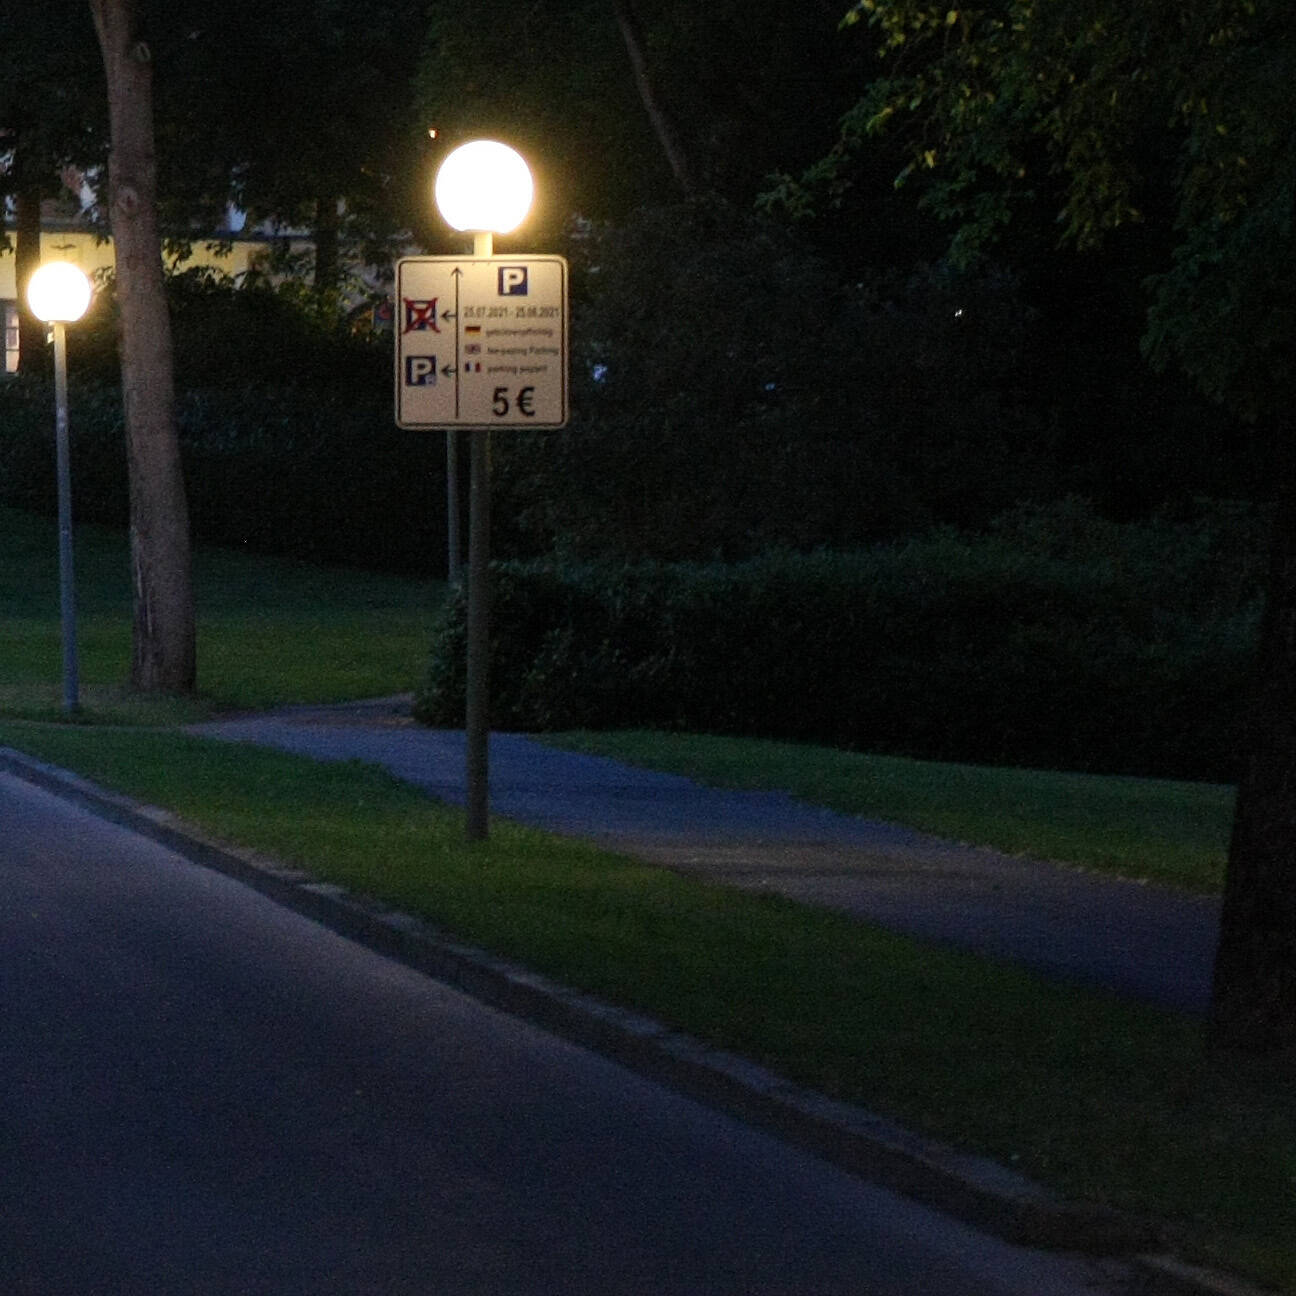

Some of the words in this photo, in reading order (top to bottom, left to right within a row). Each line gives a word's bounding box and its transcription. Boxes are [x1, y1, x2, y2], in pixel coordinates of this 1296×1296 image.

[503, 268, 524, 294] P
[493, 387, 510, 417] 5
[516, 386, 536, 418] €
